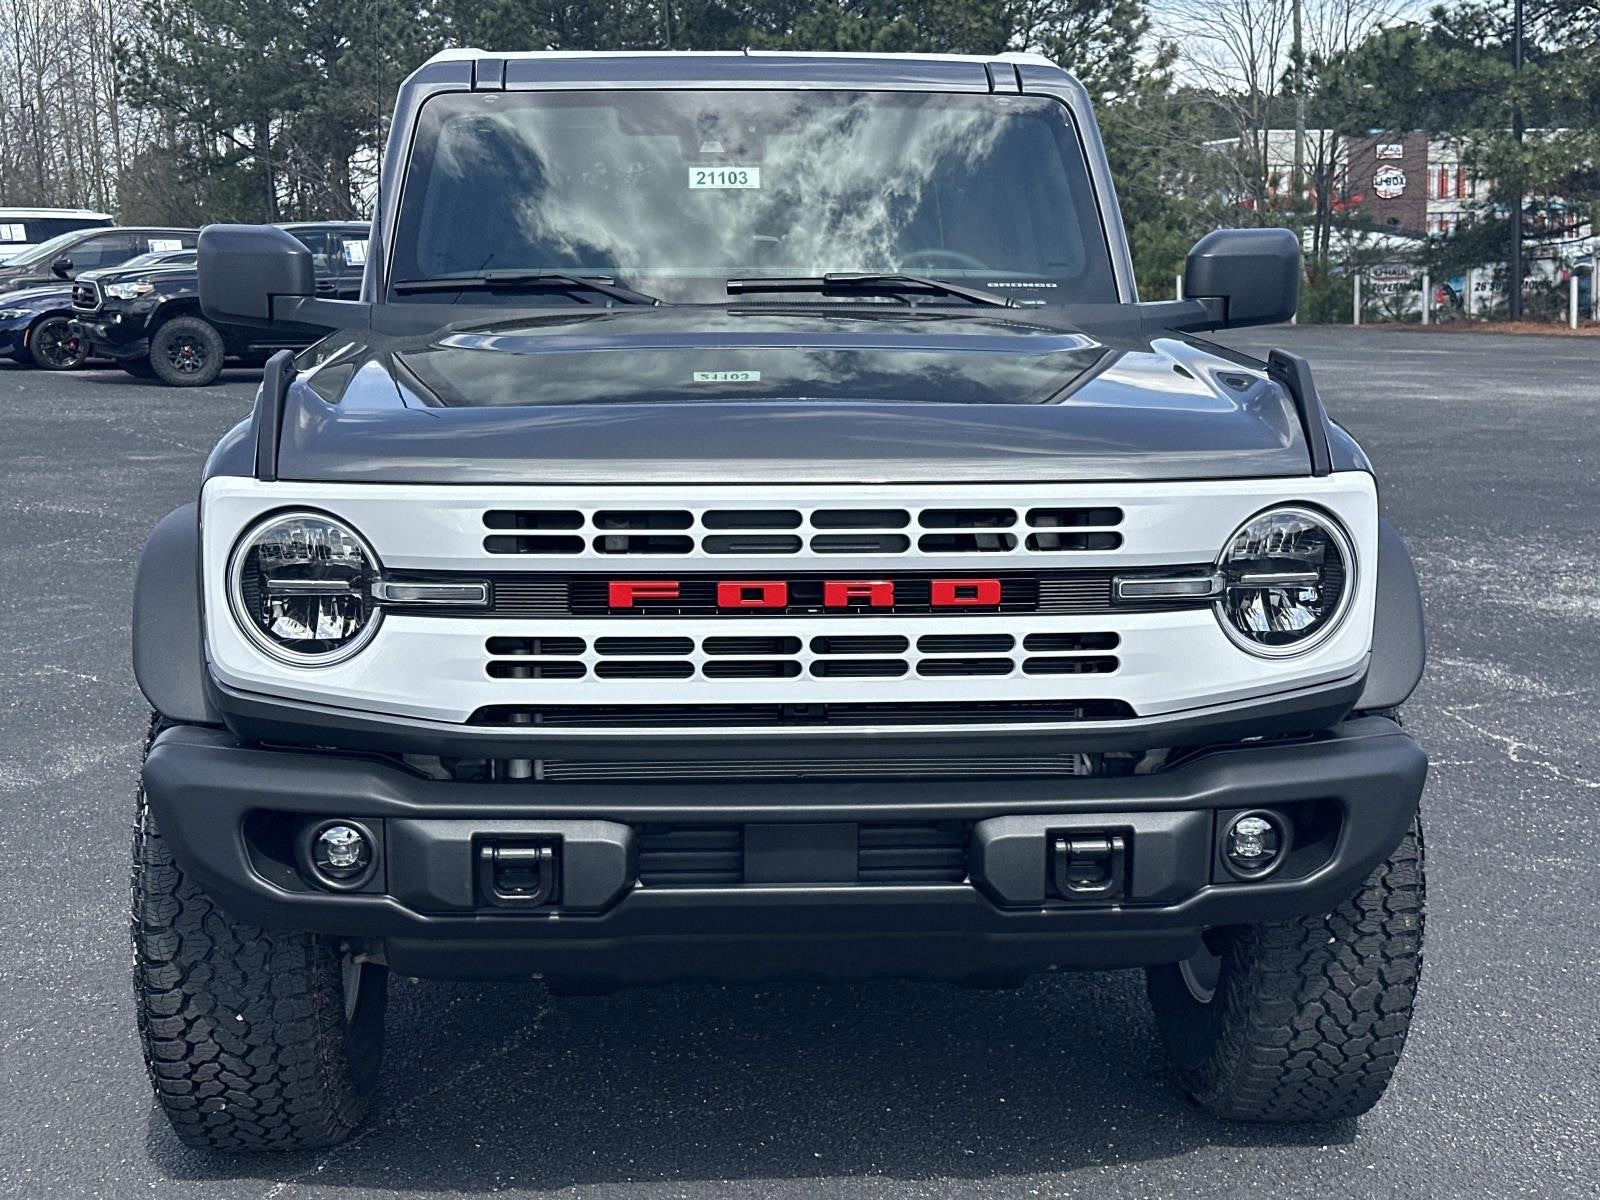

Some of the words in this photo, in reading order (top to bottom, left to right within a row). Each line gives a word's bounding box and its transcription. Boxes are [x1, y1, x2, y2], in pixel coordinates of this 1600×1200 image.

[696, 171, 748, 185] 21103
[1375, 177, 1404, 186] U-BOX
[608, 578, 1001, 608] FORD
